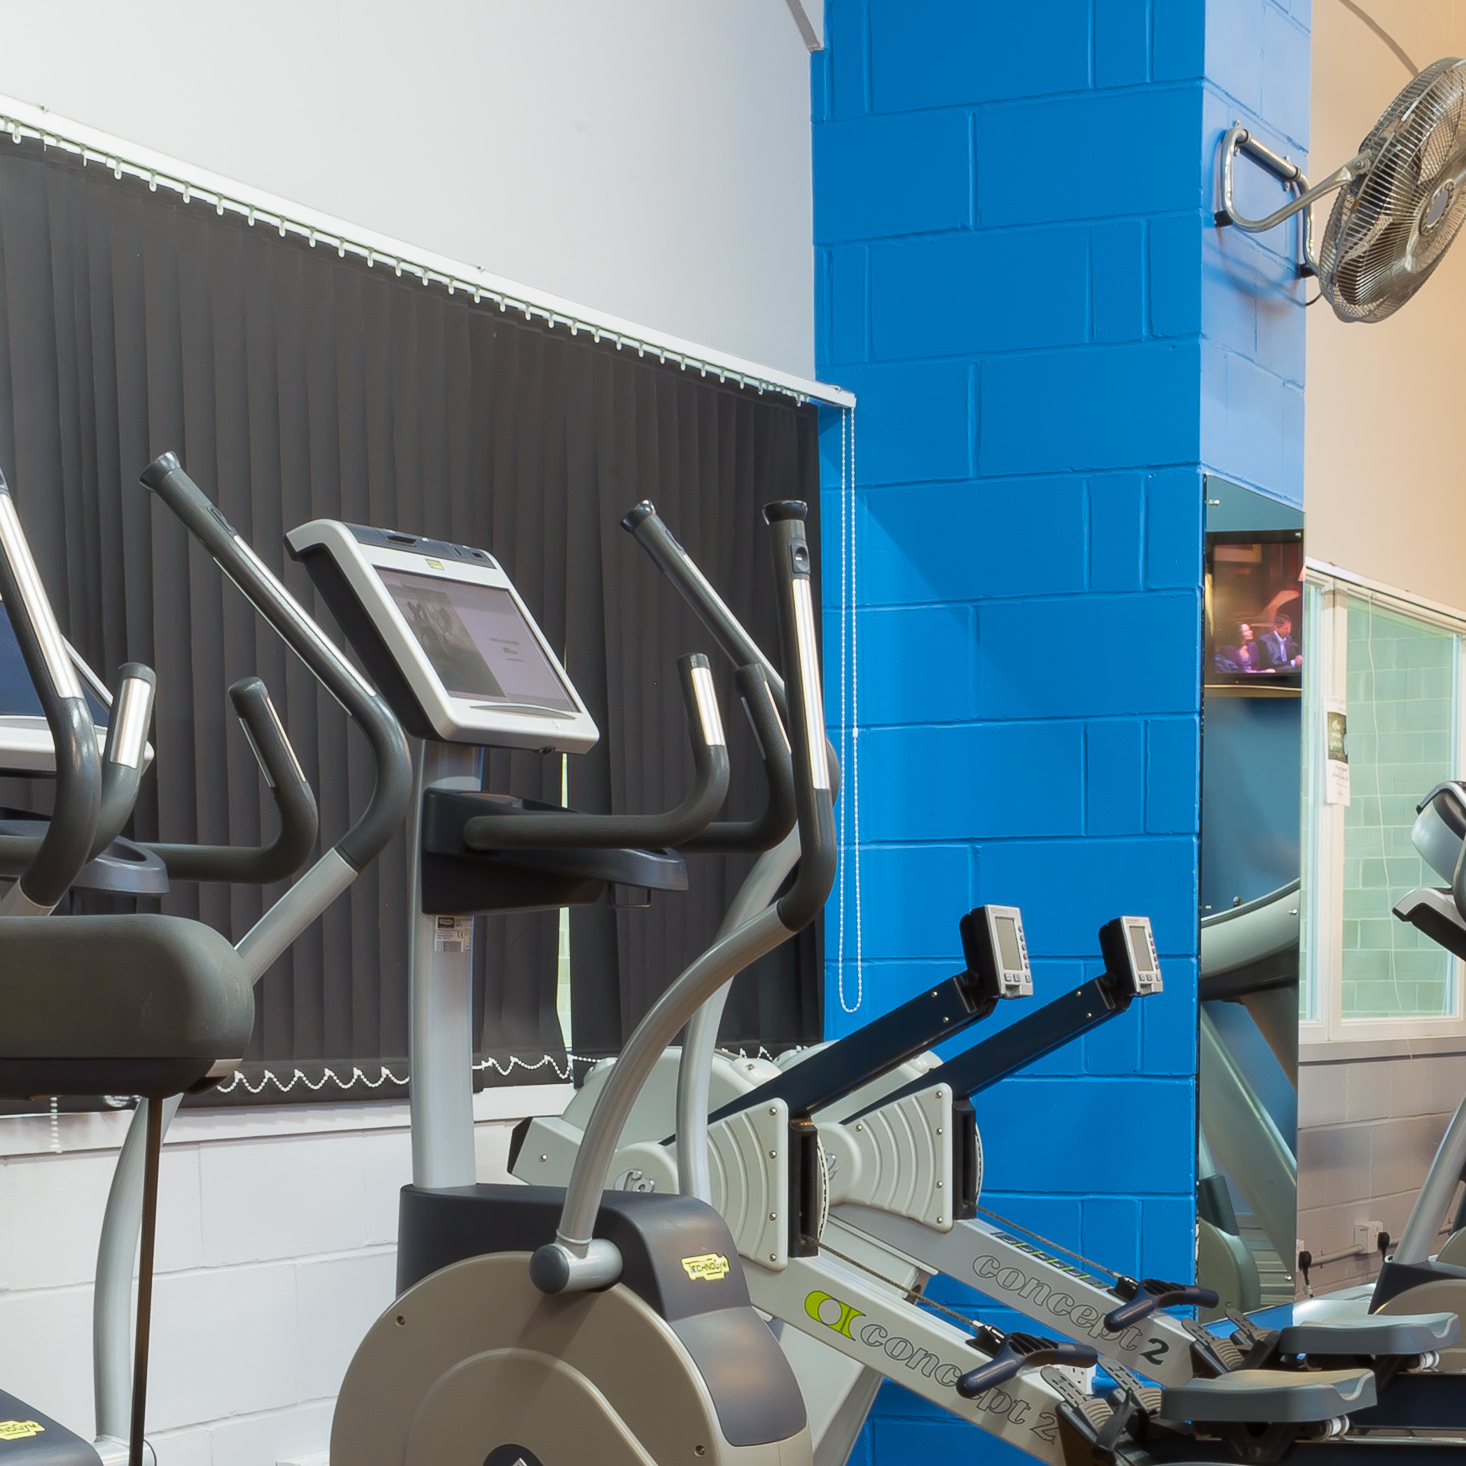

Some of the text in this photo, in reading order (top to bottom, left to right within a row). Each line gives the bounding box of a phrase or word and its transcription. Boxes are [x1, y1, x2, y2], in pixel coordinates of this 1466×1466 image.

[972, 1254, 1170, 1365] concept 2
[860, 1323, 1060, 1444] concpt 2
